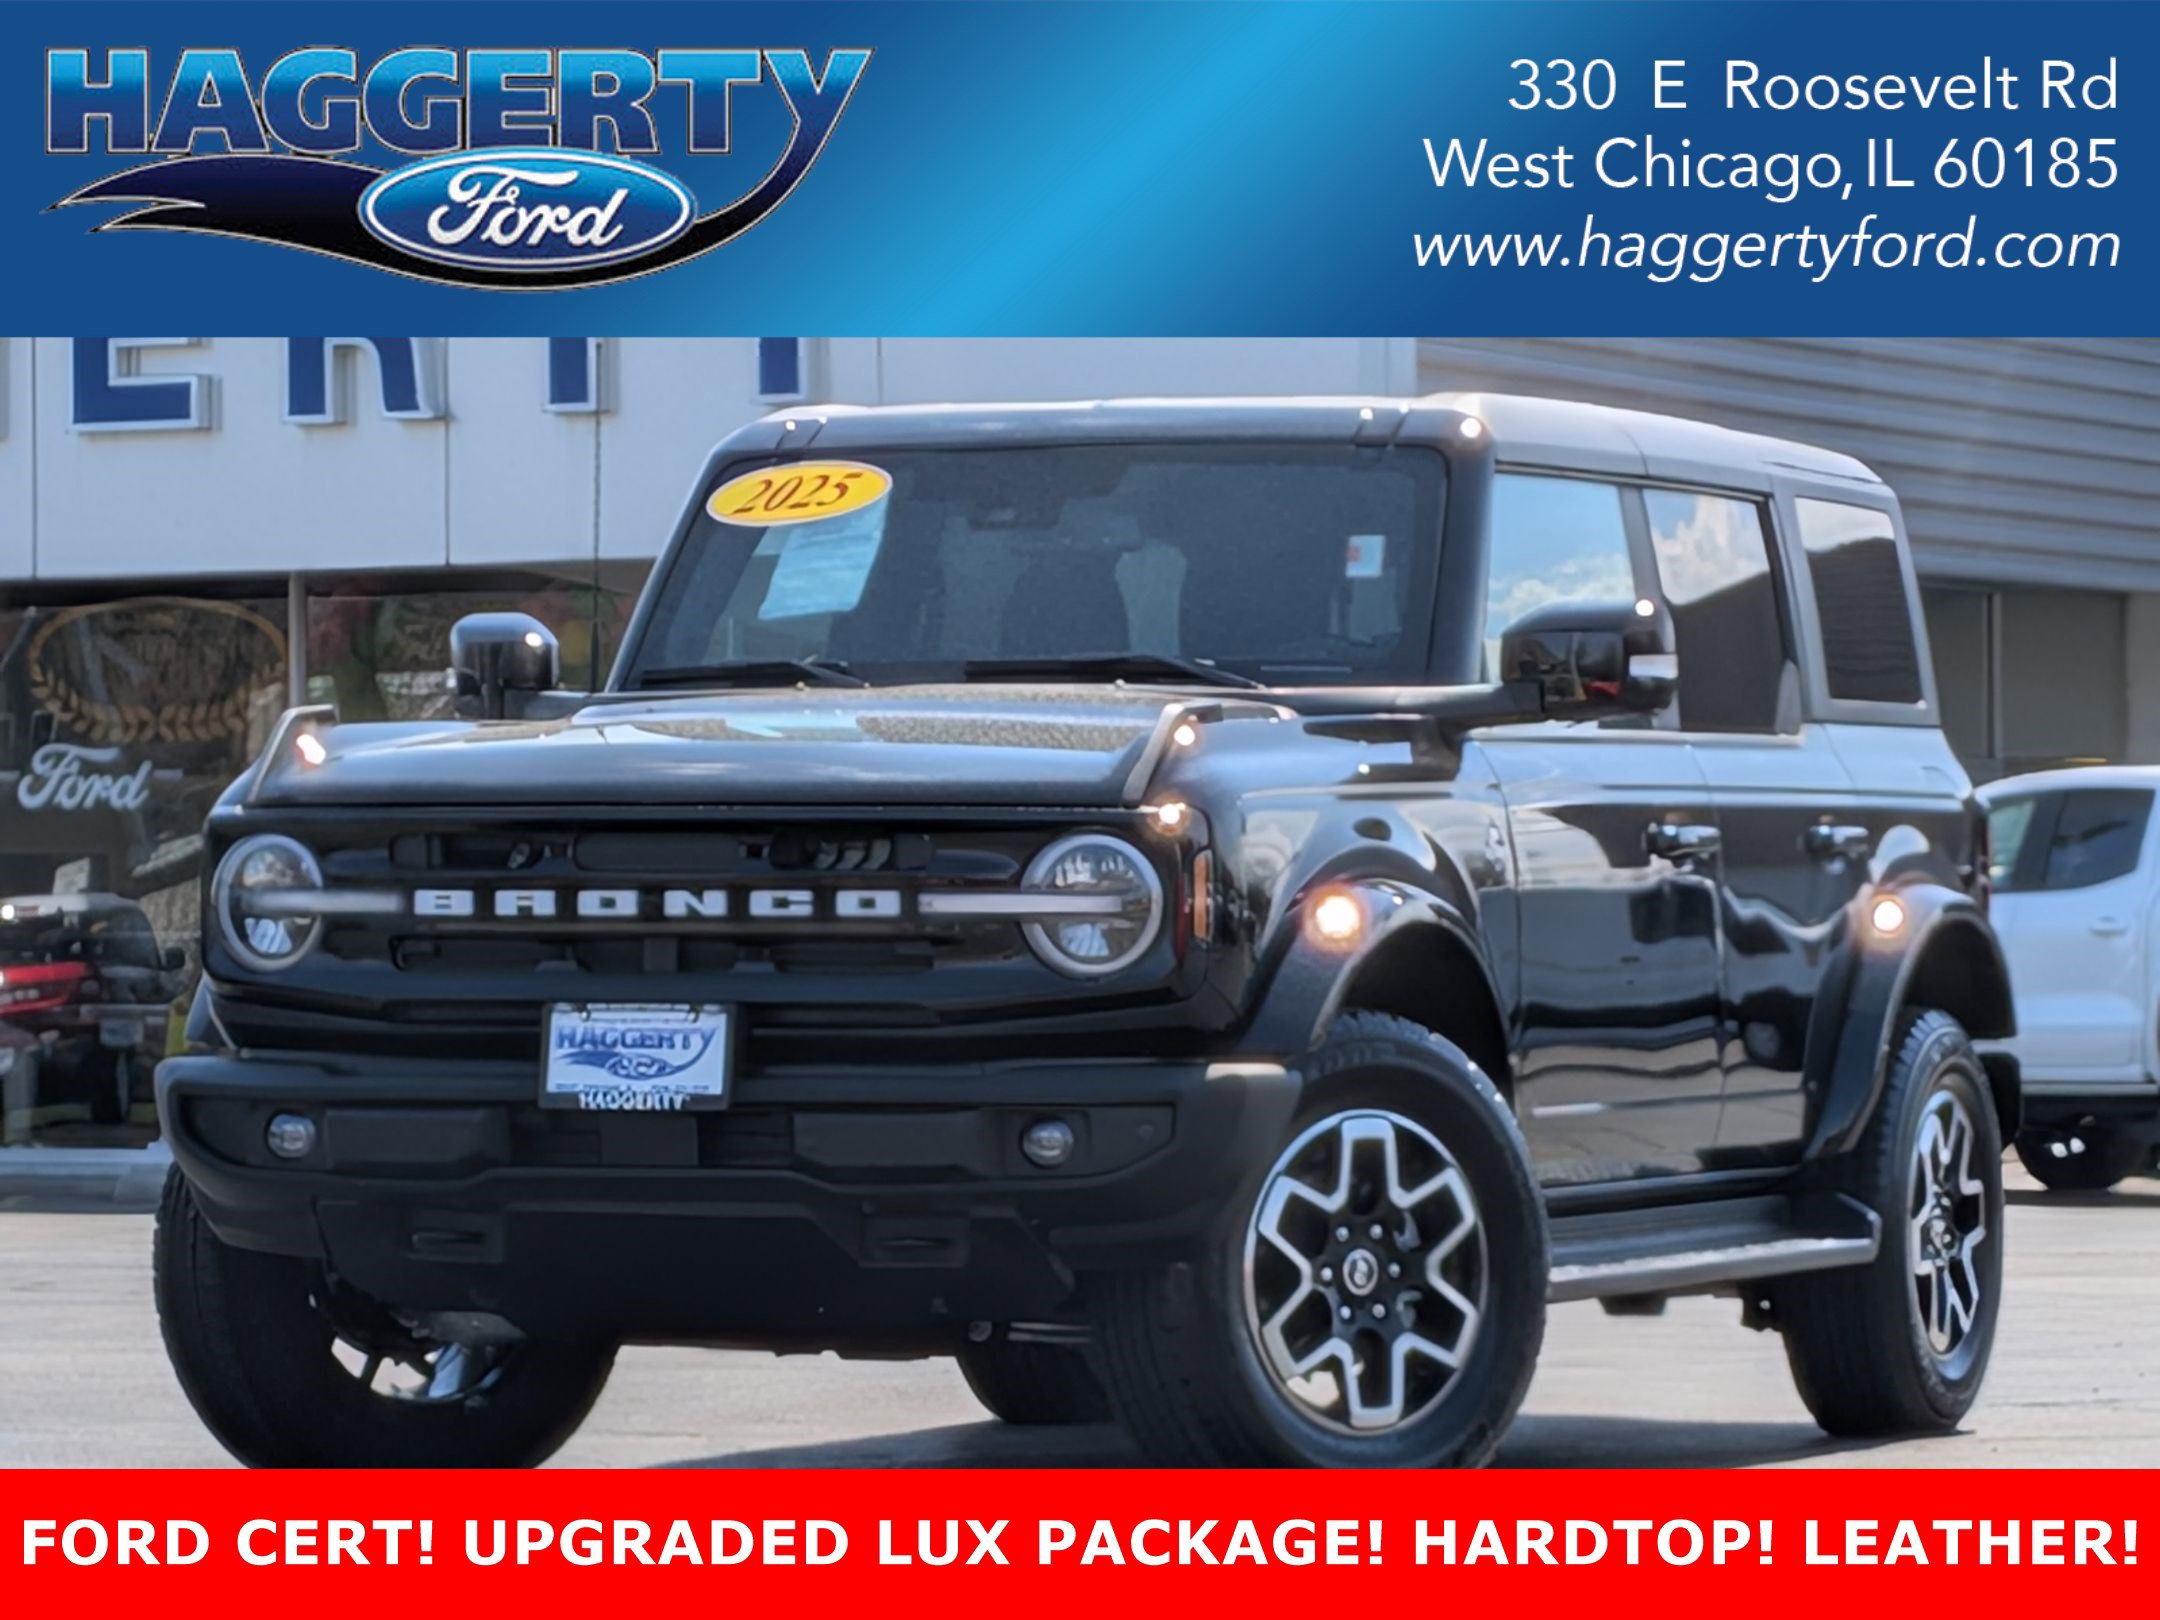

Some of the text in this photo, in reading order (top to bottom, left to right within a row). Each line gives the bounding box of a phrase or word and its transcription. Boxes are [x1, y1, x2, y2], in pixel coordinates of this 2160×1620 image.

[732, 471, 864, 515] 2025
[16, 742, 153, 811] Ford
[413, 888, 900, 917] BRONCO
[556, 1026, 717, 1050] HAGGERTY
